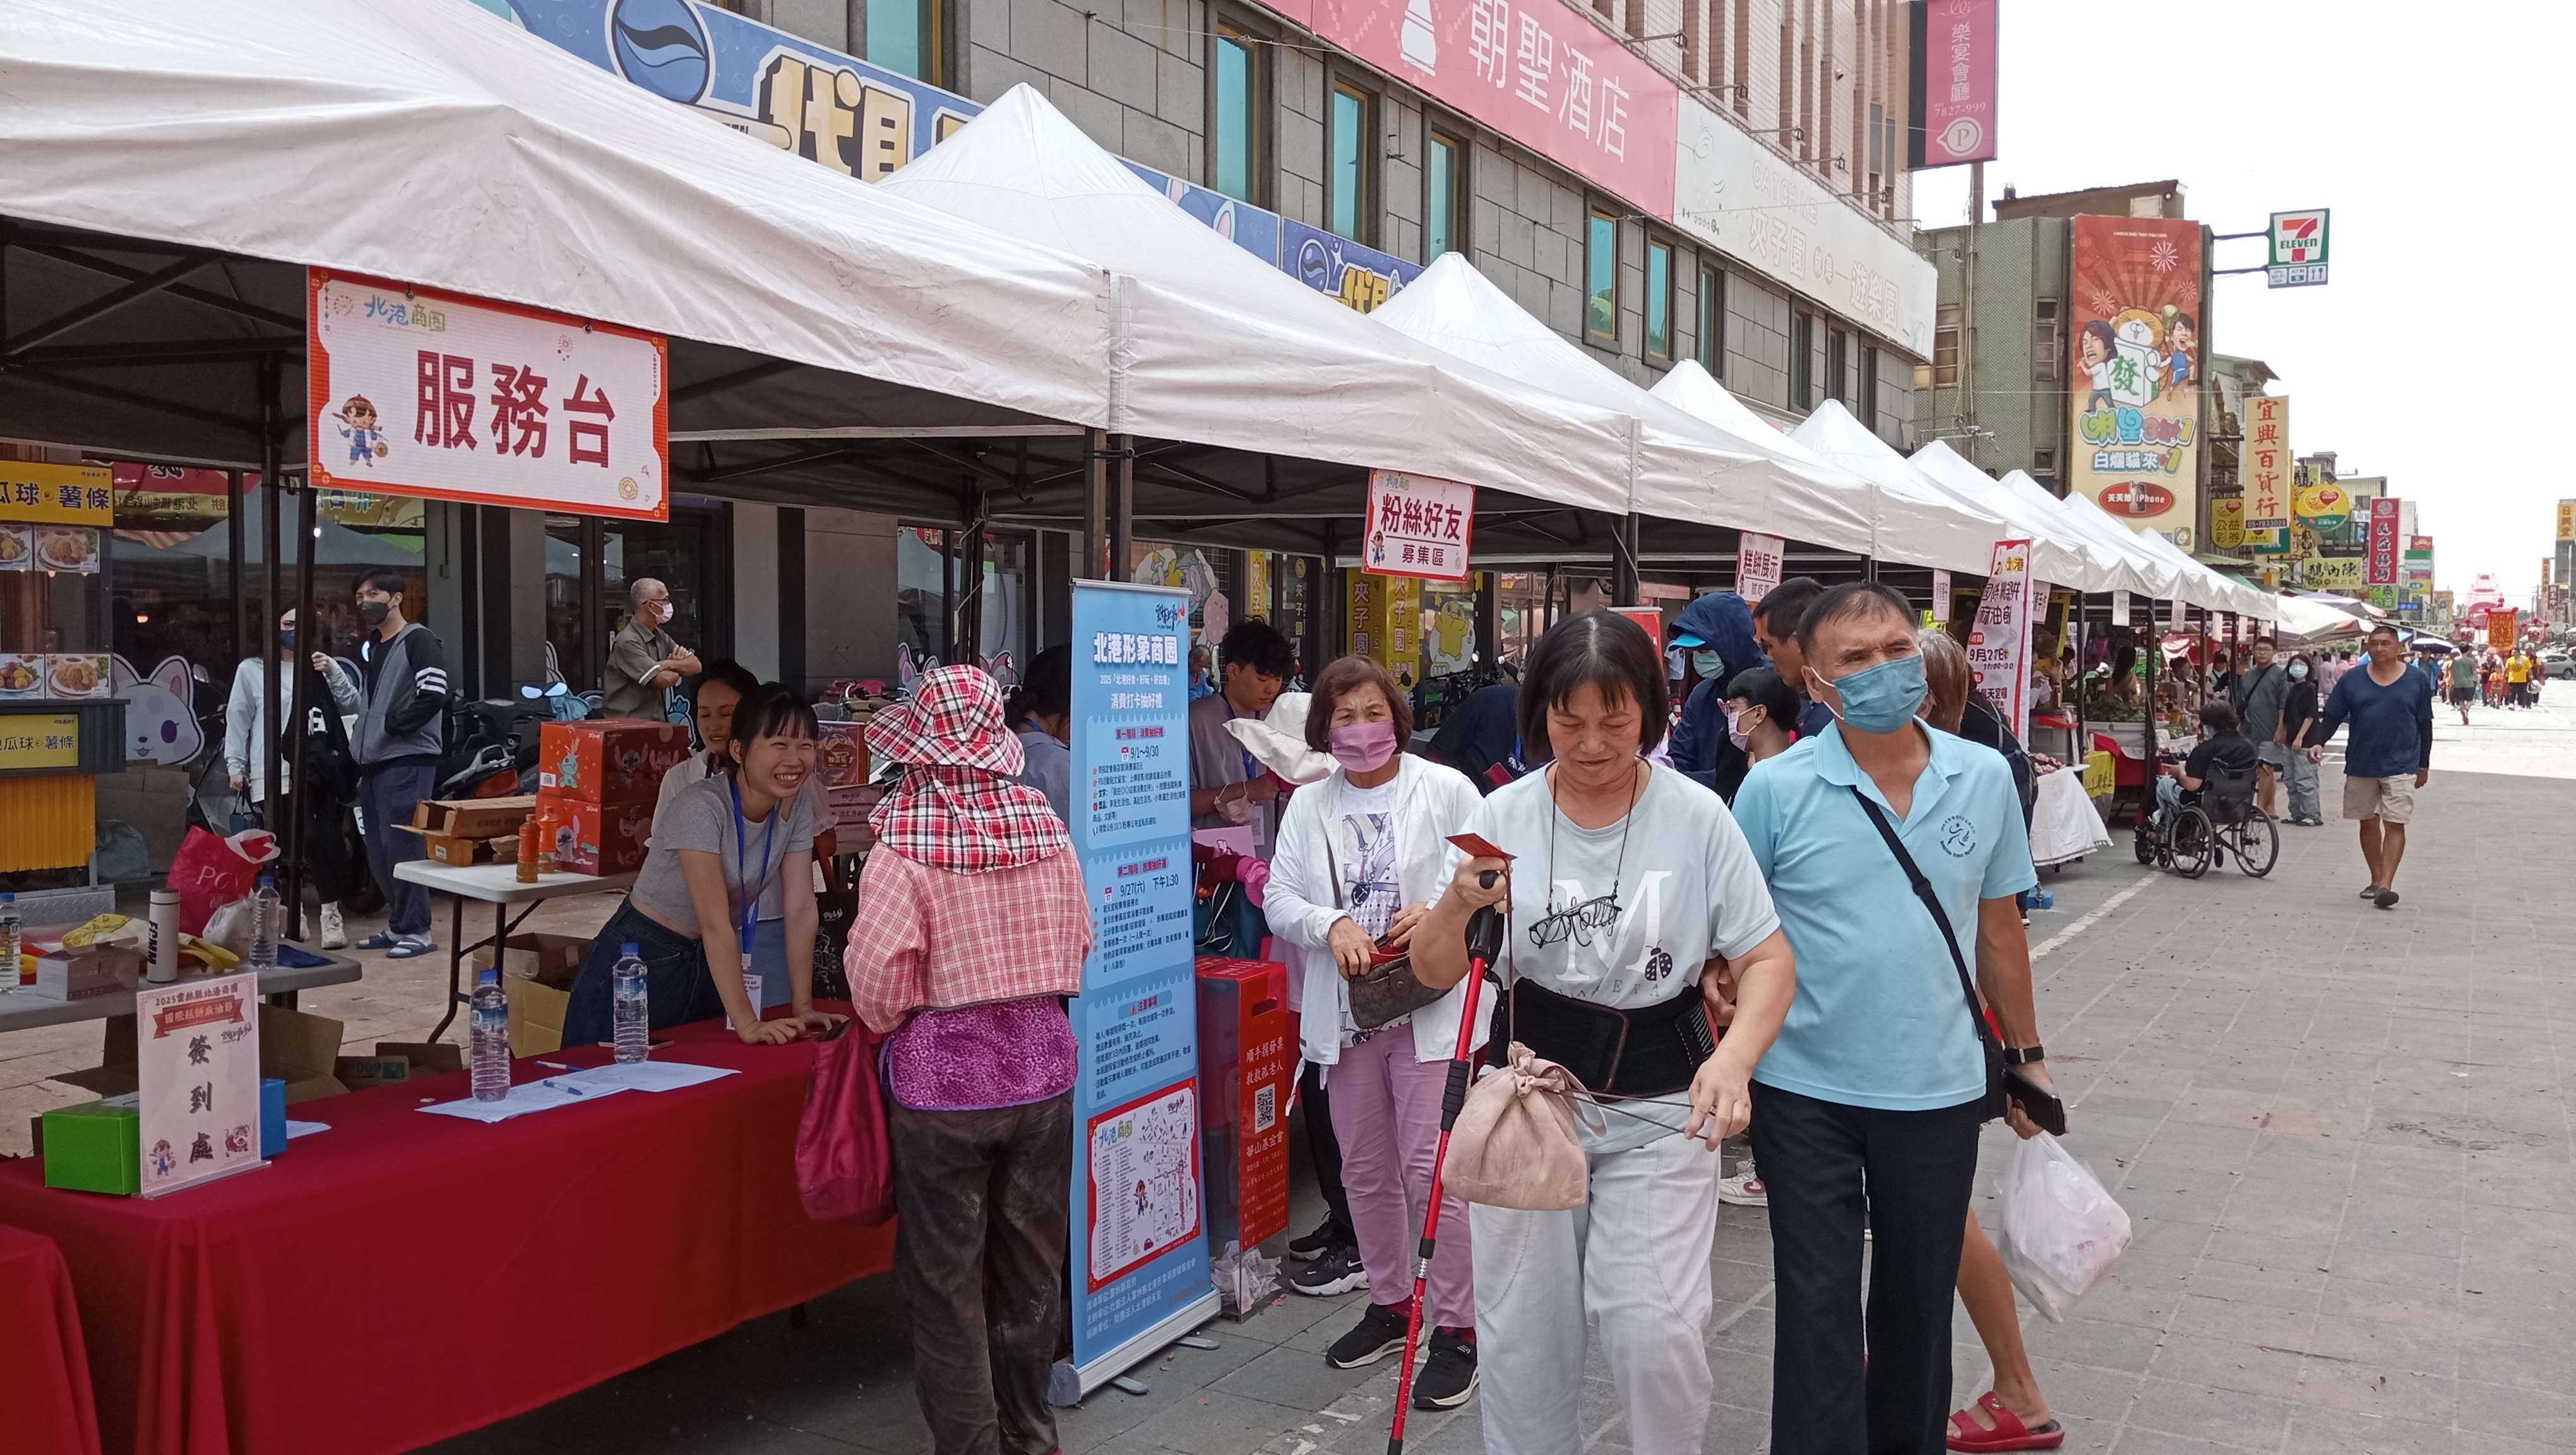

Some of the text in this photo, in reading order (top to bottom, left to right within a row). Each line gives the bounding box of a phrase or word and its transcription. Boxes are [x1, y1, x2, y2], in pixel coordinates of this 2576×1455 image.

[1469, 0, 1630, 163] 朝聖酒店
[1934, 101, 1986, 119] 7827-999
[2282, 218, 2317, 261] 7
[364, 294, 445, 332] 北港商圈
[2110, 354, 2142, 396] 發
[414, 350, 616, 469] 服務台
[2254, 399, 2279, 517] 宜興百貨行
[59, 485, 109, 510] 薯條
[1381, 493, 1462, 540] 粉絲好友
[1402, 544, 1444, 566] 募集區
[1252, 561, 1263, 621] 夾子
[1354, 581, 1369, 654] 夾子園
[1094, 632, 1178, 664] 北港形象商圈
[0, 736, 33, 751] 瓜球
